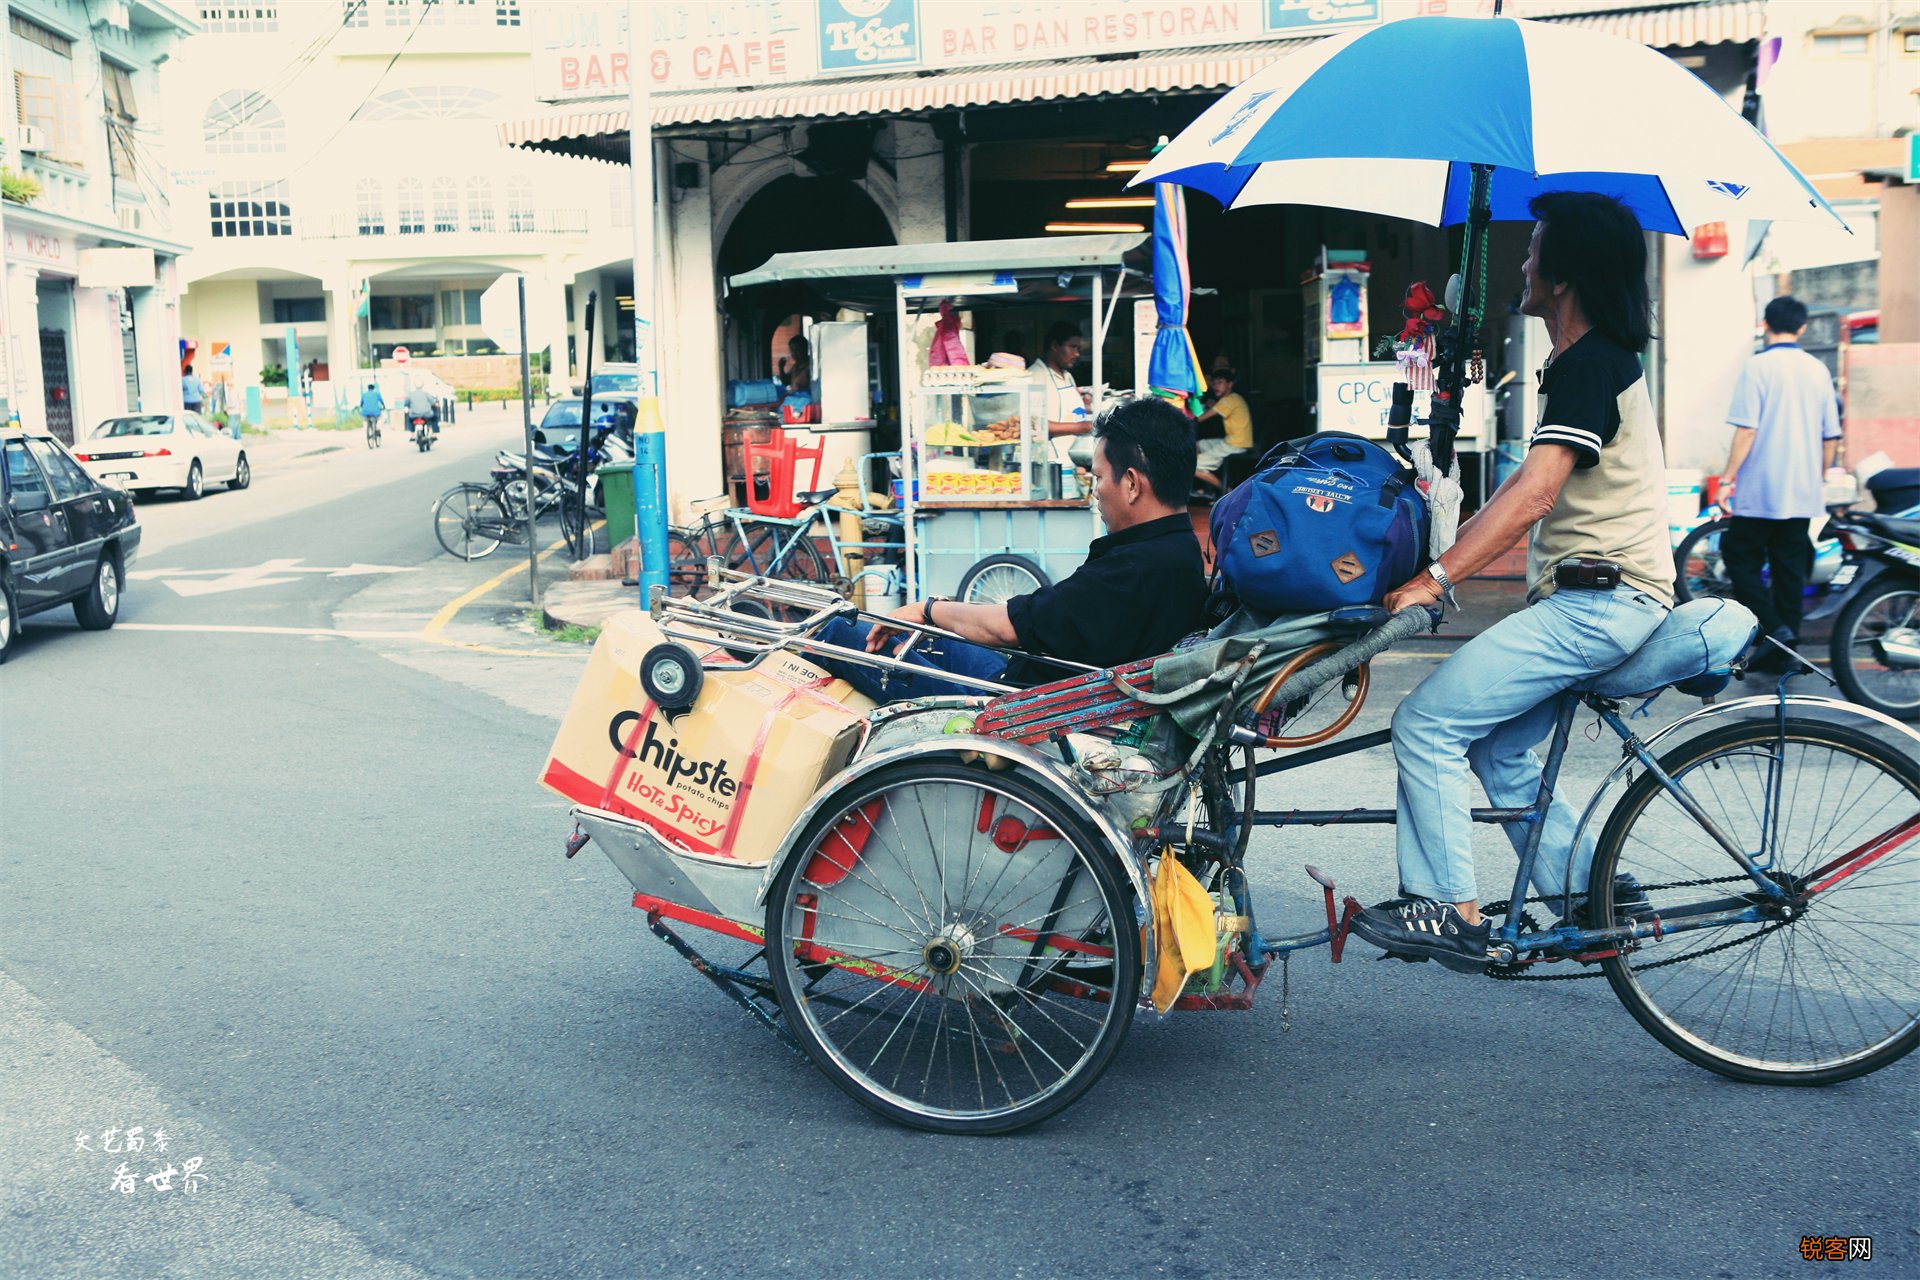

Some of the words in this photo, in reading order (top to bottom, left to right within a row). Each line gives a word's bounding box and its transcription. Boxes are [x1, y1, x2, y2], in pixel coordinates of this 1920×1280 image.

[616, 5, 688, 45] FNG
[826, 17, 910, 61] Tiger
[943, 26, 997, 54] BAR
[1014, 19, 1069, 48] DAN
[1085, 3, 1239, 42] RESTORAN
[561, 53, 629, 88] BAR
[650, 50, 671, 80] &
[693, 40, 786, 78] CAFE
[26, 231, 61, 259] WORLD
[1338, 381, 1381, 404] CPC
[1326, 491, 1352, 501] ACTIVE
[609, 710, 752, 800] Chipster
[664, 794, 726, 837] Spicy
[676, 782, 705, 799] potato
[707, 796, 729, 811] chips
